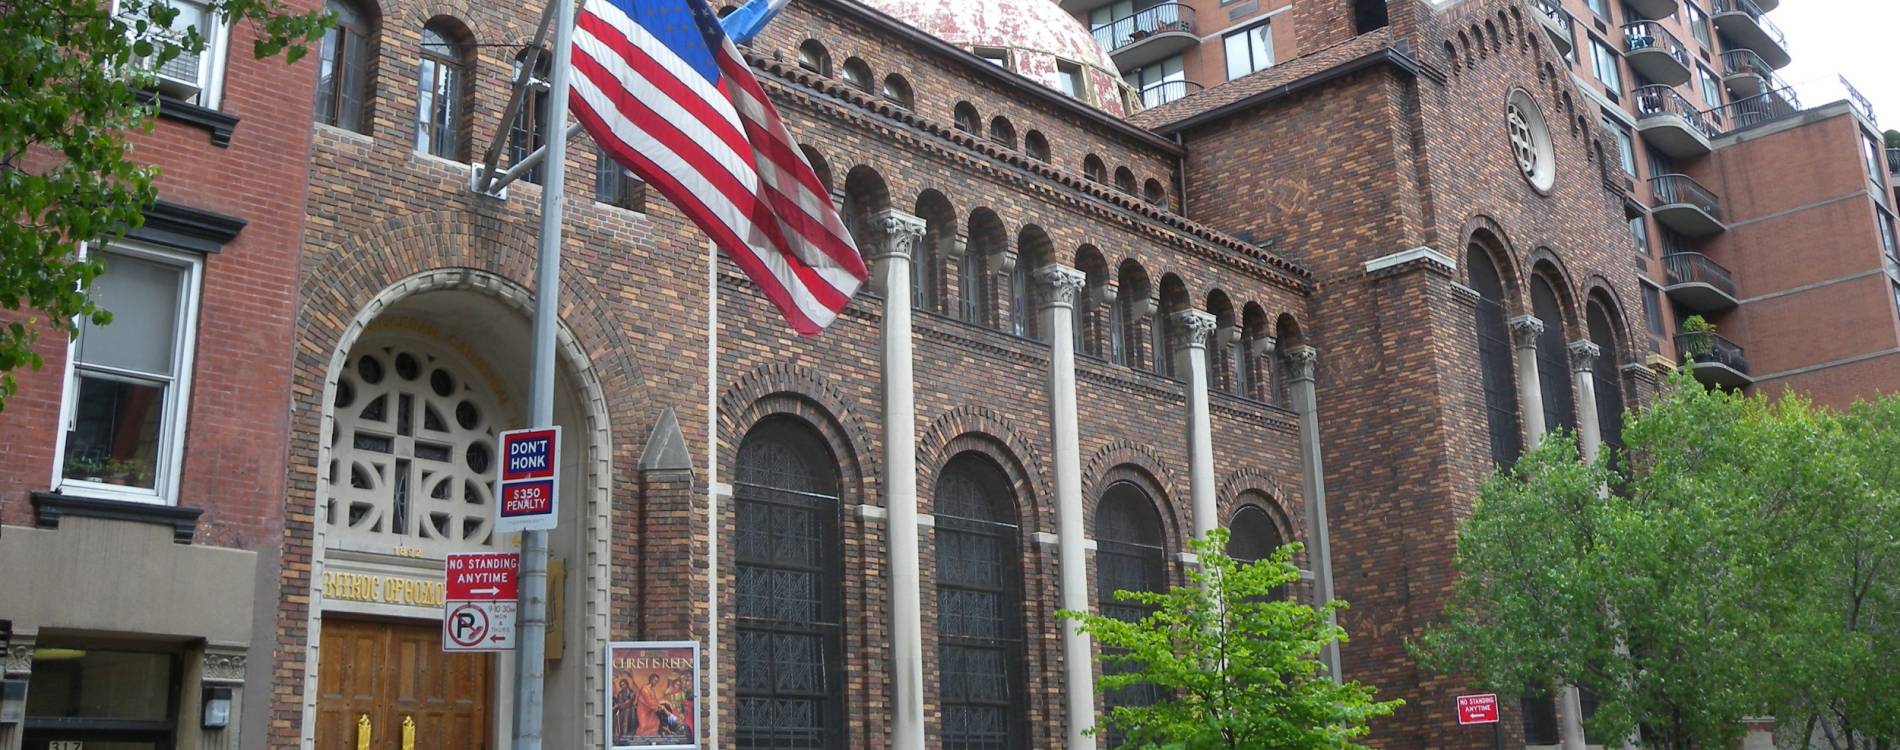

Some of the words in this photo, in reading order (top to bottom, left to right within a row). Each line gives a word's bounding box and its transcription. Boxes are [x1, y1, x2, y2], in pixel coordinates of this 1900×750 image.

[511, 440, 547, 455] DON'T
[511, 456, 545, 470] HONK
[513, 487, 541, 500] $350
[507, 498, 546, 512] PENALTY
[450, 559, 463, 570] NO
[469, 558, 517, 569] STANDING
[457, 572, 508, 584] ANYTIME
[613, 657, 650, 669] CHRIST
[652, 657, 661, 669] IS
[662, 657, 694, 669] RISEN
[52, 742, 81, 750] 317
